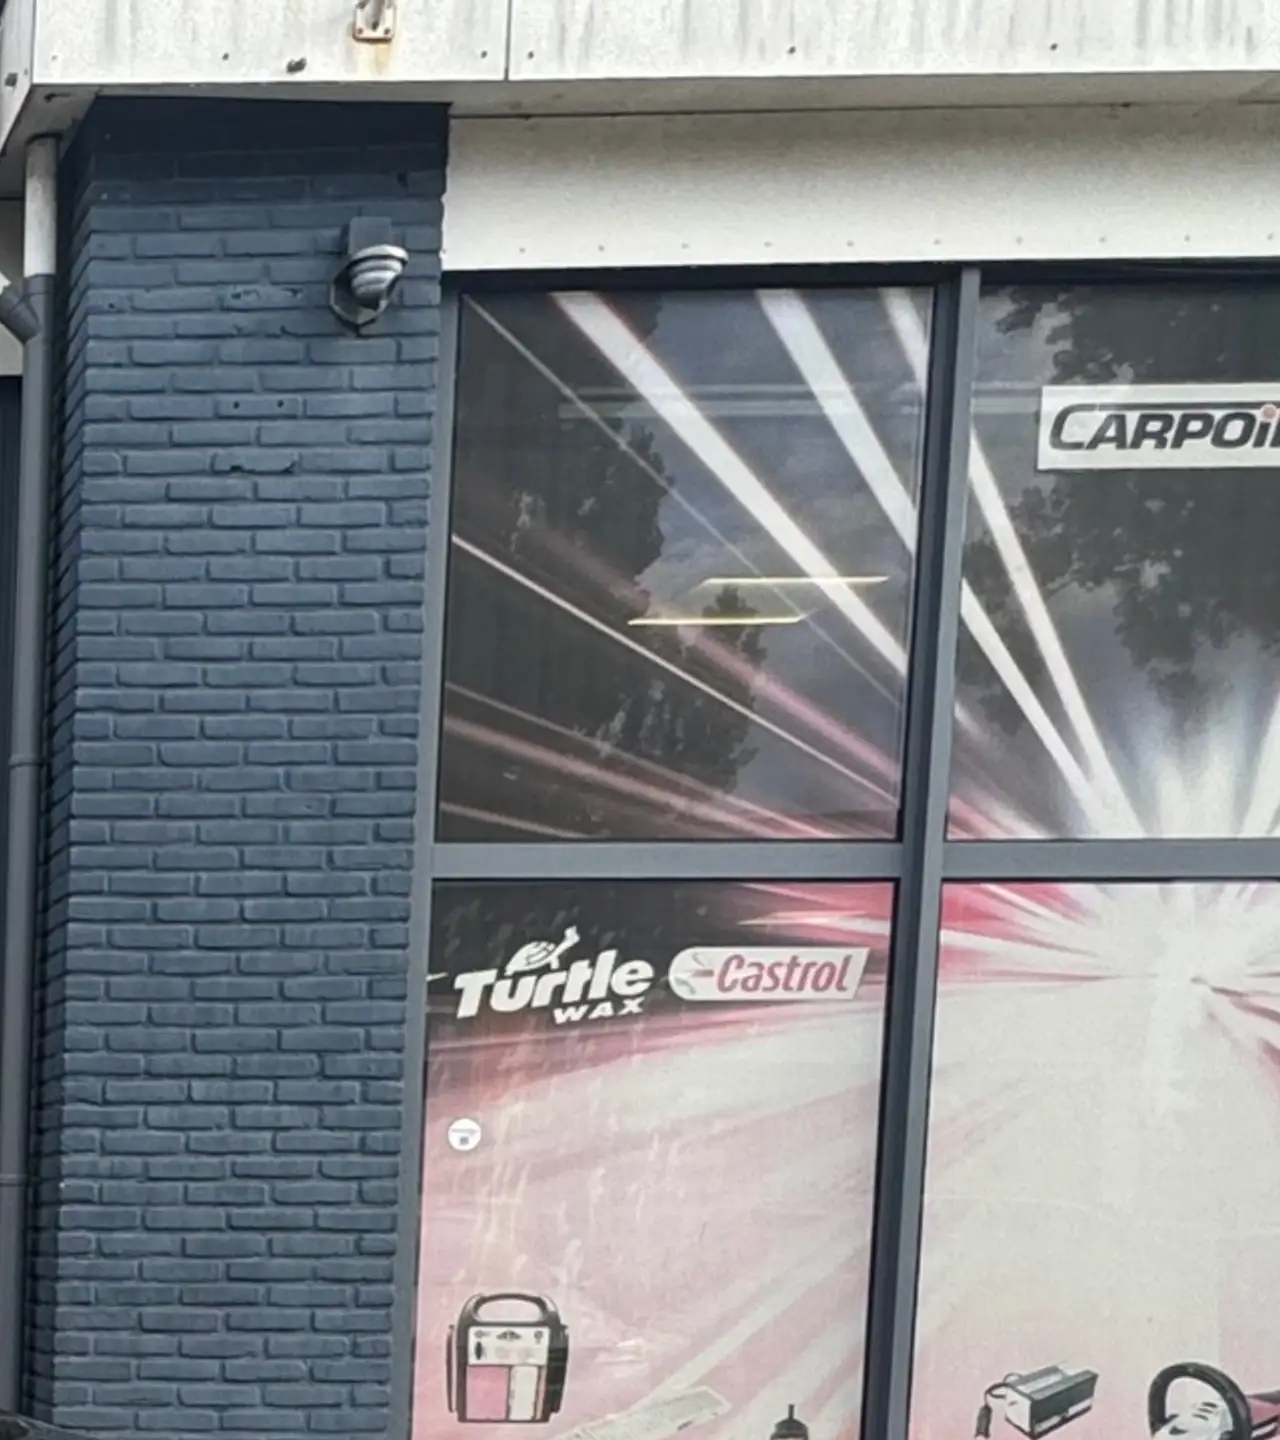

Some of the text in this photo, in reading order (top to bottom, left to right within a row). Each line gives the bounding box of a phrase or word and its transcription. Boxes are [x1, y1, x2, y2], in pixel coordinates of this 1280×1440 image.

[454, 949, 655, 1019] Turtle
[717, 953, 853, 993] Castrol
[553, 999, 645, 1025] WAX
